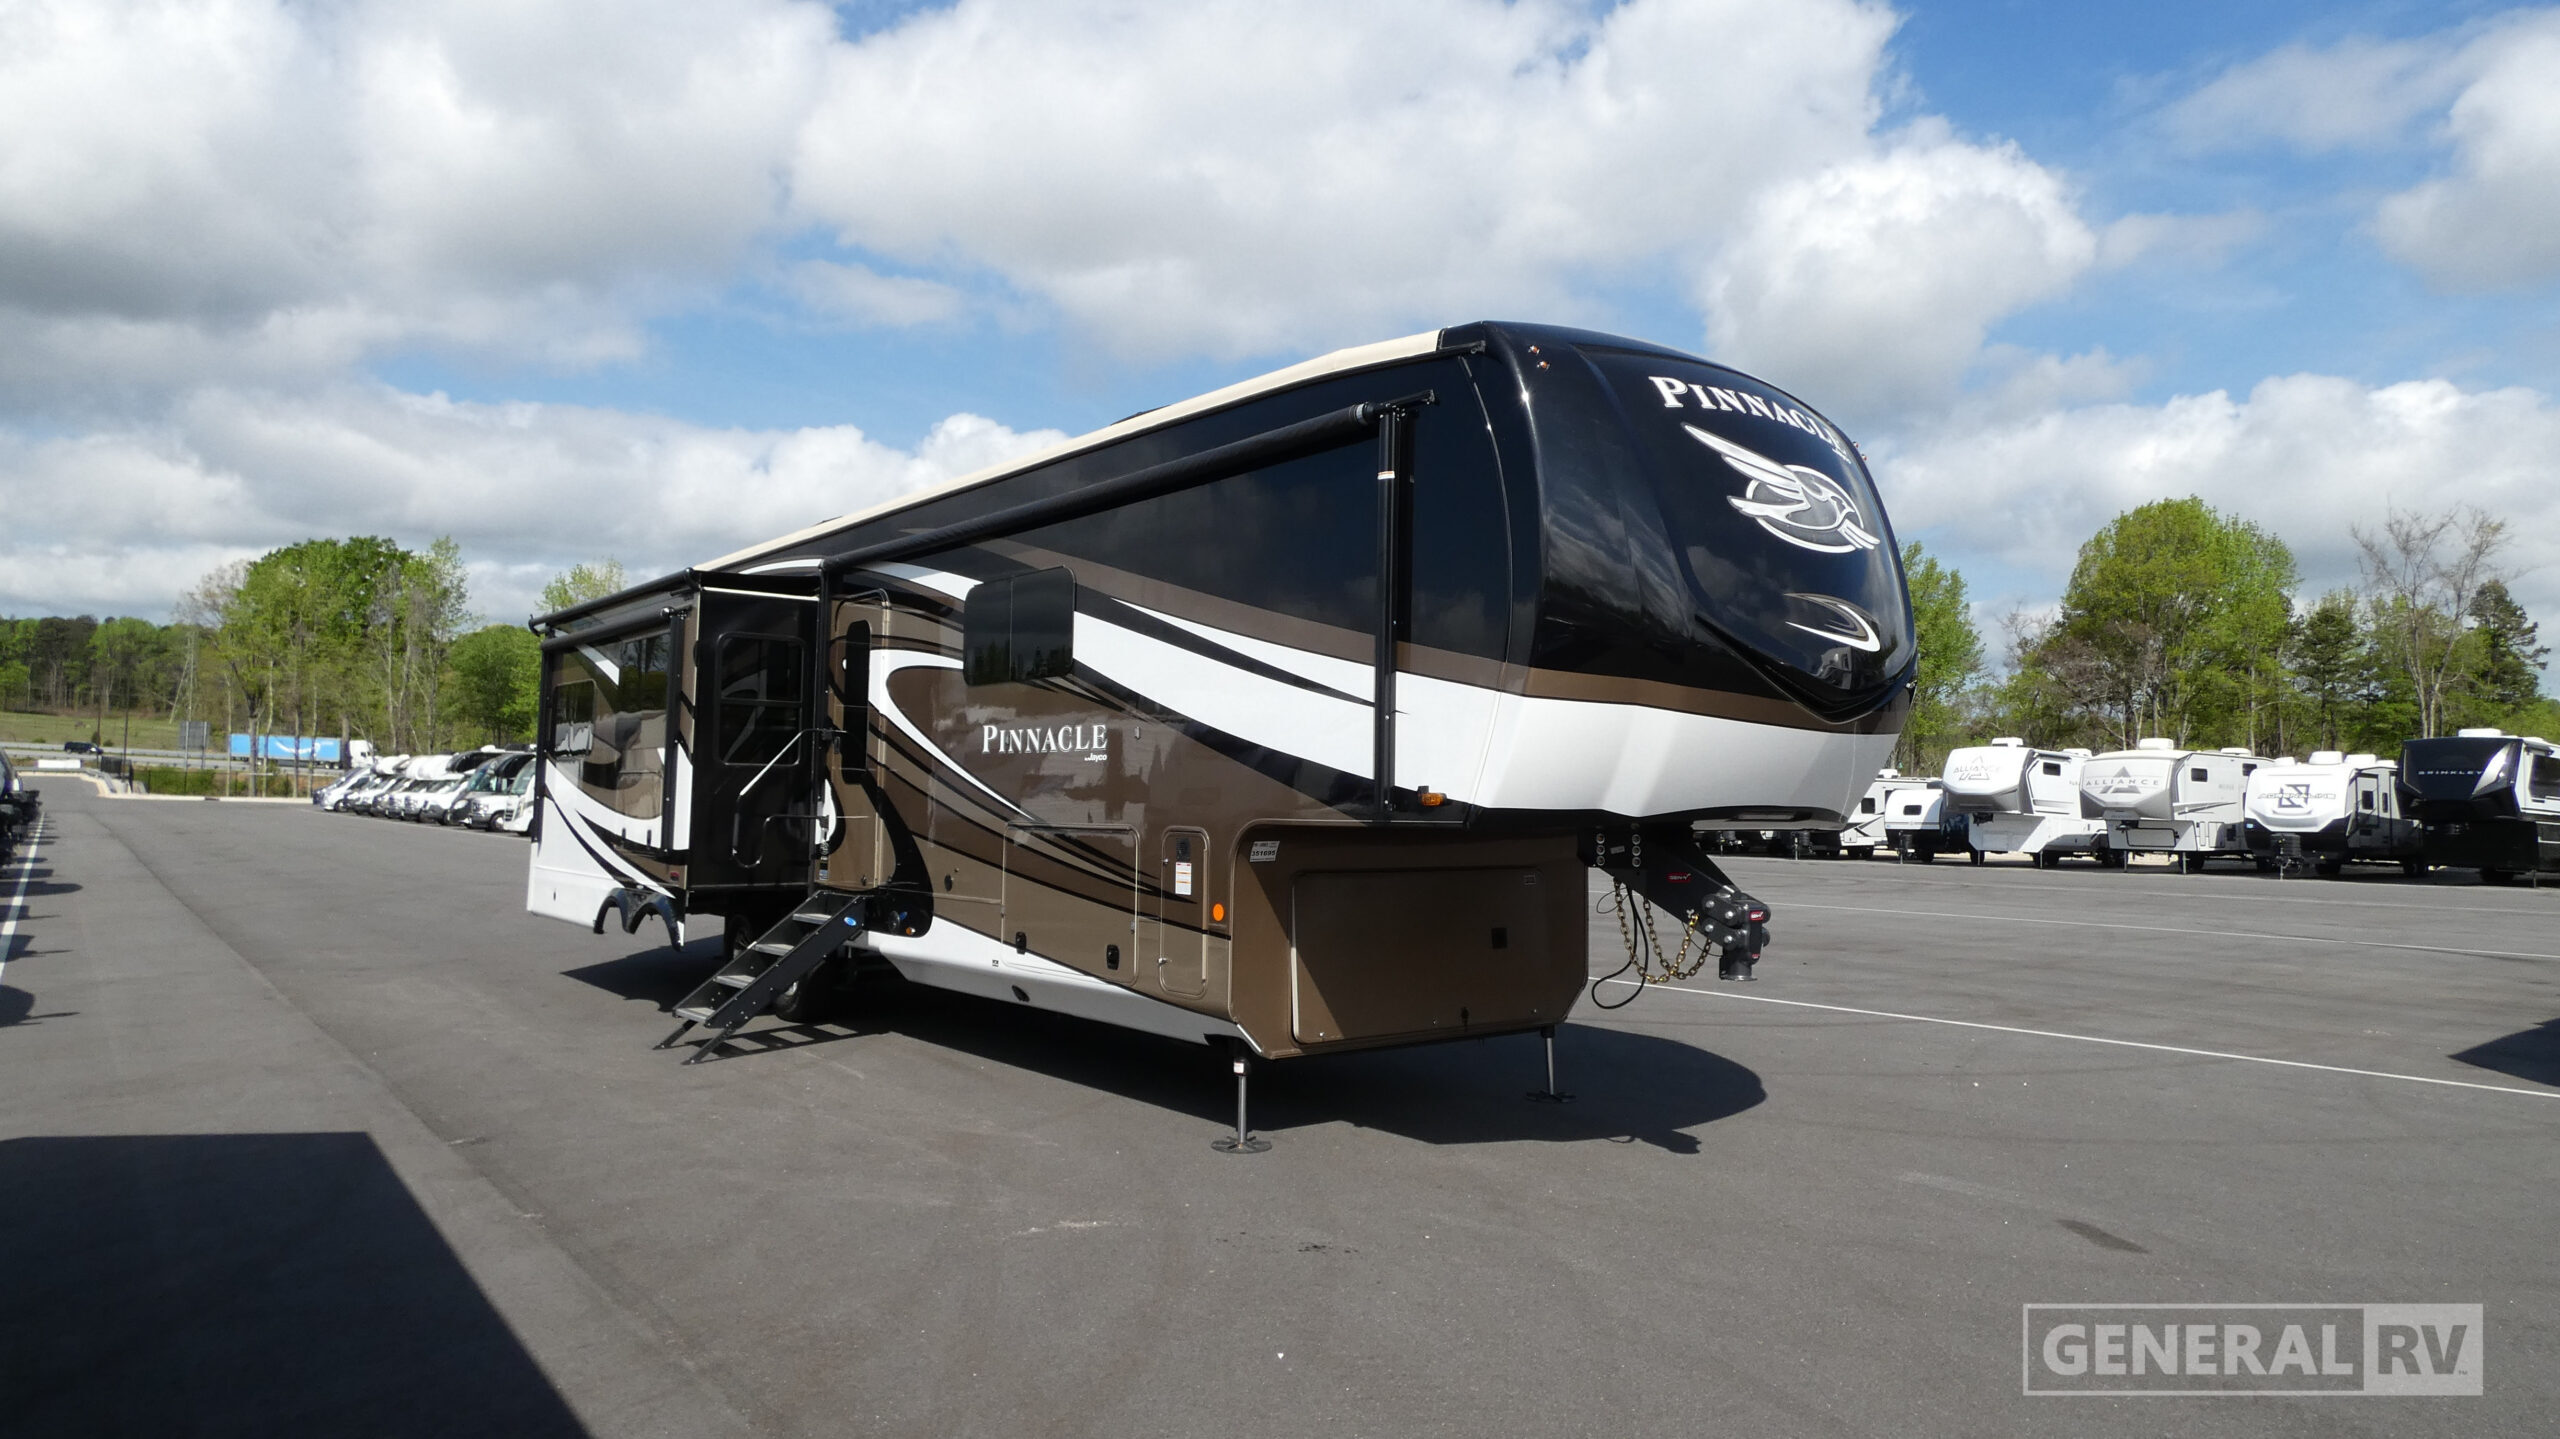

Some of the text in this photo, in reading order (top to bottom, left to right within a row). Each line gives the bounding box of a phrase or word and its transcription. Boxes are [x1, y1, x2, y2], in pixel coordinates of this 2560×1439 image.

[1648, 375, 1852, 464] PINNACLE
[982, 724, 1108, 752] PINNACLE
[2086, 778, 2160, 787] ALLIANCE
